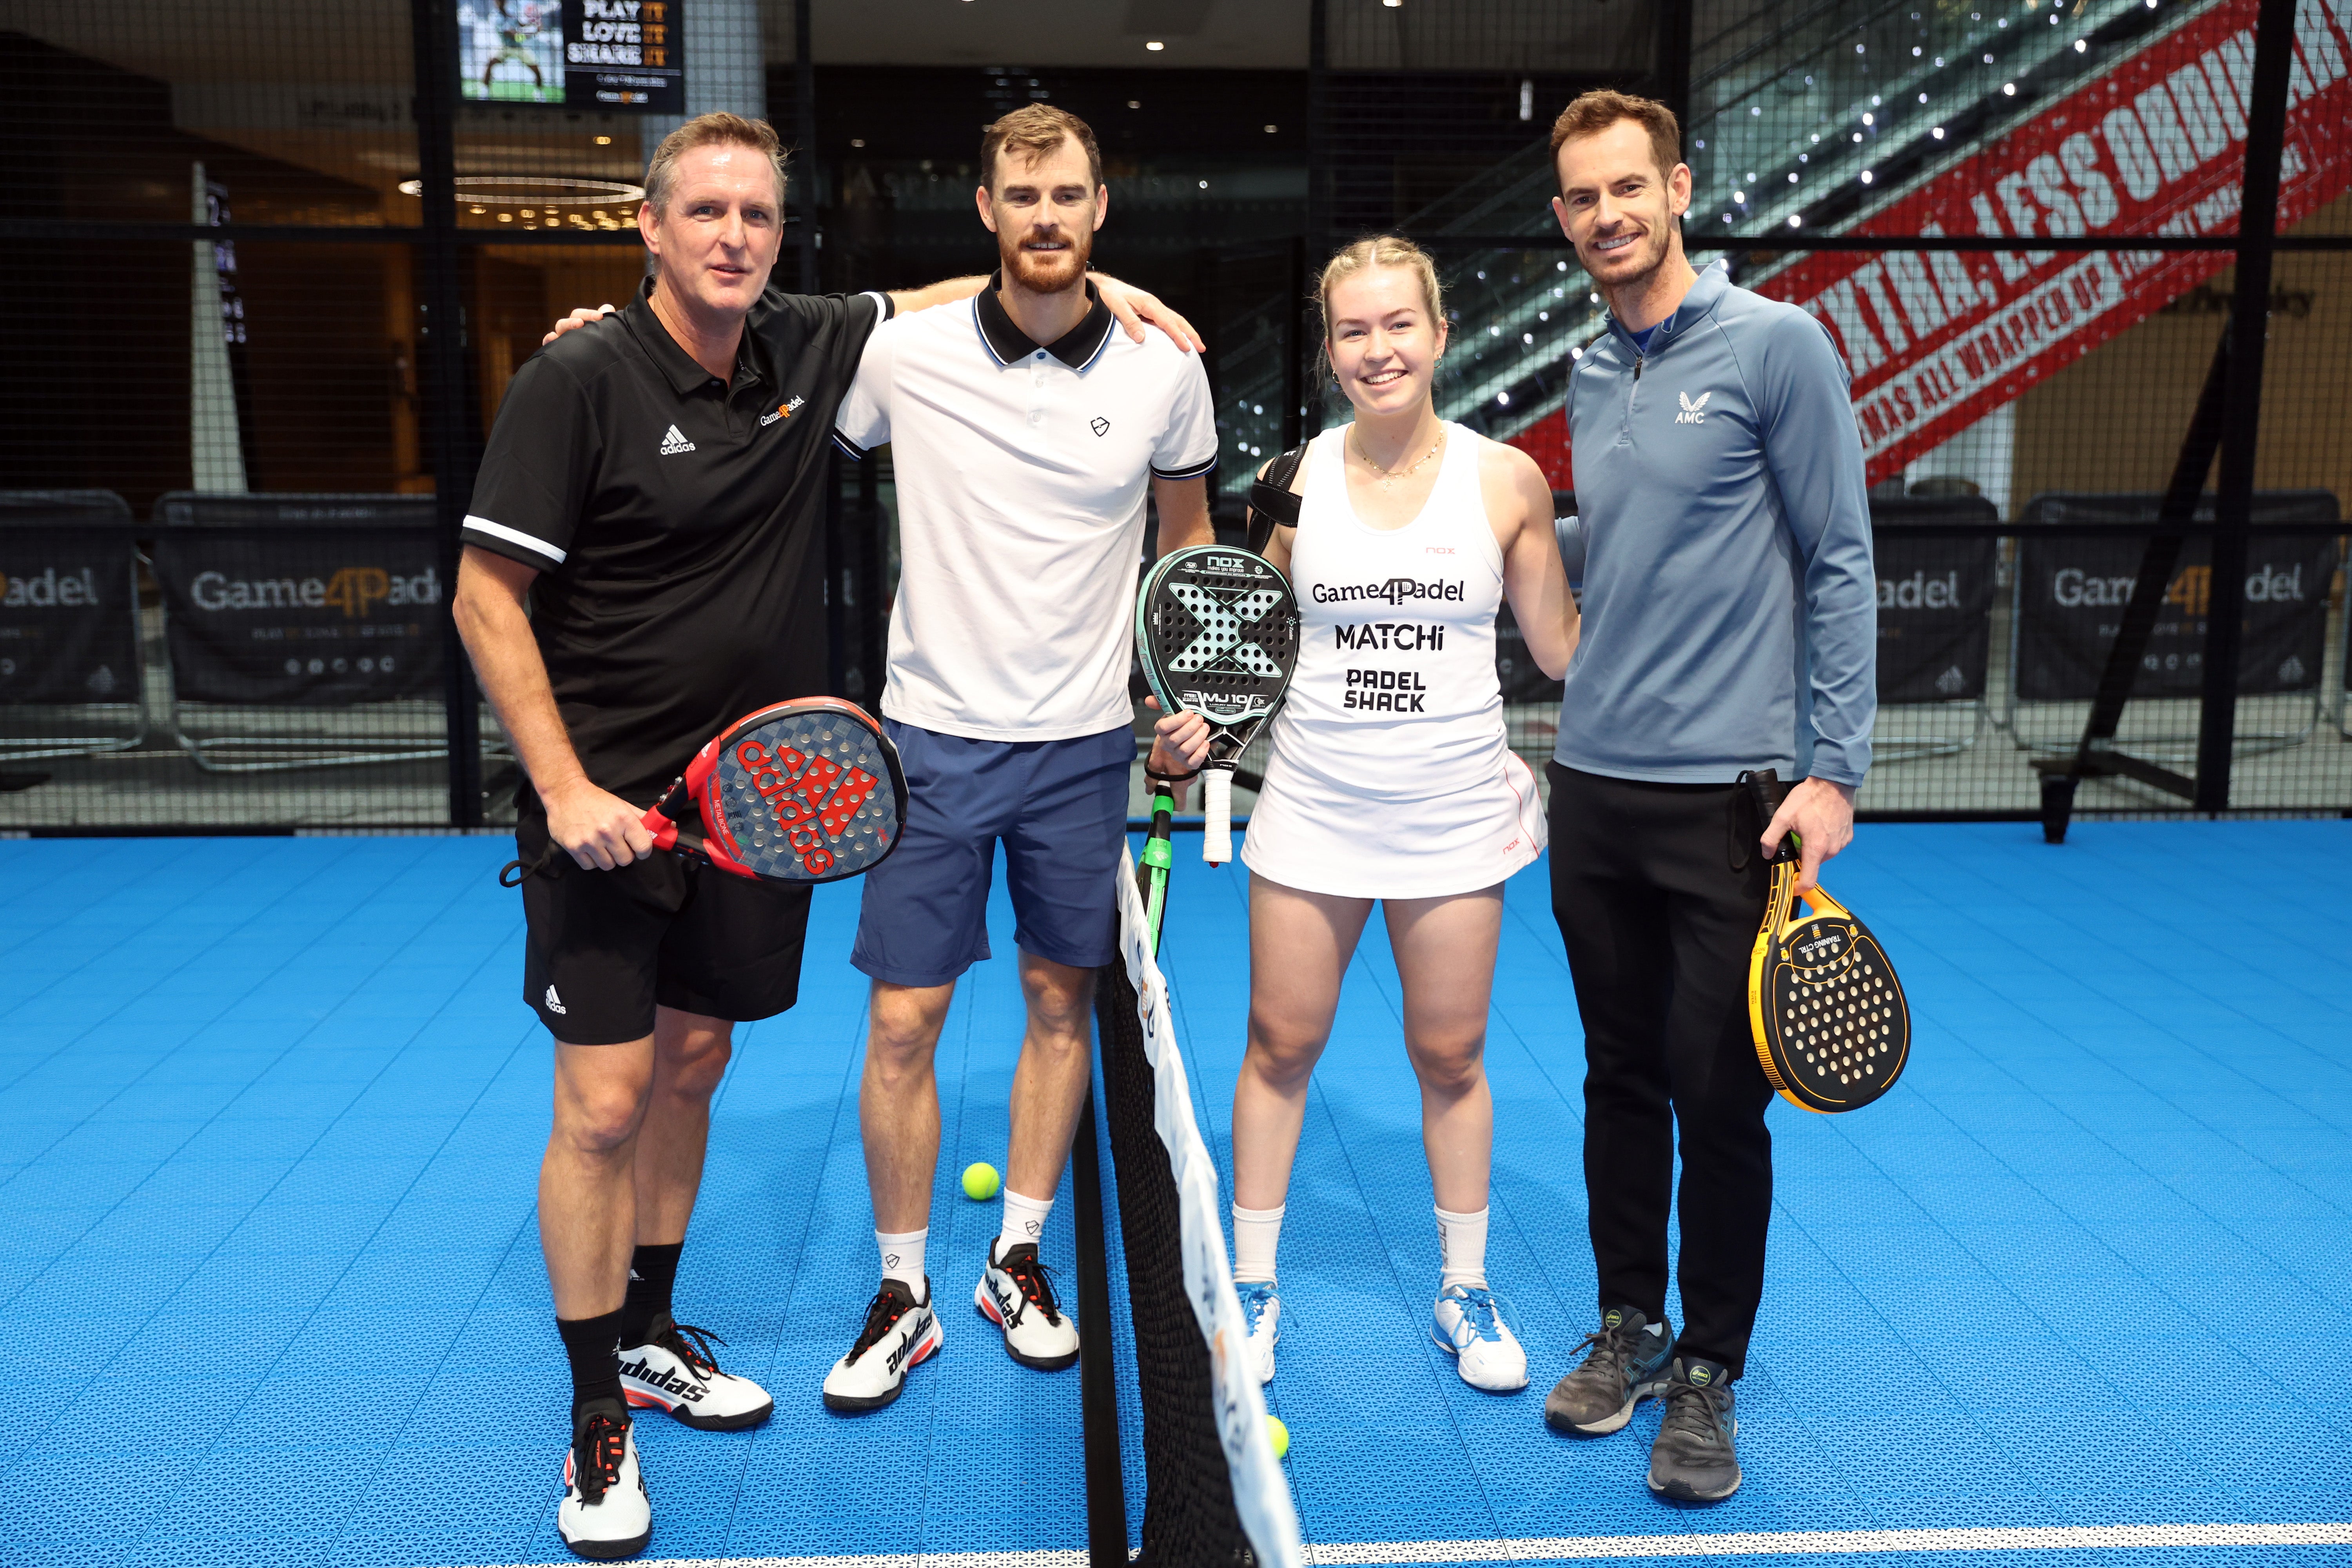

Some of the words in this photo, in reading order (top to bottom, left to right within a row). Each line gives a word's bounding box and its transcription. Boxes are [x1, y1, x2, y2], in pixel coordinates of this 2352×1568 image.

[583, 0, 641, 21] PLAY
[641, 2, 668, 22] IT
[582, 21, 642, 43] LOVE
[642, 24, 668, 44] IT
[567, 42, 642, 65] SHARE
[643, 45, 669, 66] IT
[1800, 221, 1998, 378] XTRA,
[1971, 131, 2120, 283] LESS
[1916, 356, 1960, 409] ALL
[1957, 289, 2073, 380] WRAPPED
[2069, 265, 2101, 309] UP
[760, 395, 805, 426] Game4Padel
[1675, 412, 1704, 424] AMC
[660, 442, 696, 456] adidas
[191, 565, 440, 618] Game4Pad
[1313, 579, 1464, 605] Game4Padel
[1876, 570, 1960, 609] adel
[1335, 624, 1444, 651] MATCHi
[1346, 669, 1426, 690] PADEL
[1203, 693, 1229, 703] MJ
[1231, 694, 1248, 704] 10
[1344, 690, 1425, 712] SHACK
[714, 799, 729, 835] METALBONE
[737, 740, 834, 875] adidas
[1798, 943, 1814, 955] CTRL
[1814, 935, 1841, 948] TRAINING
[618, 1357, 711, 1403] didas
